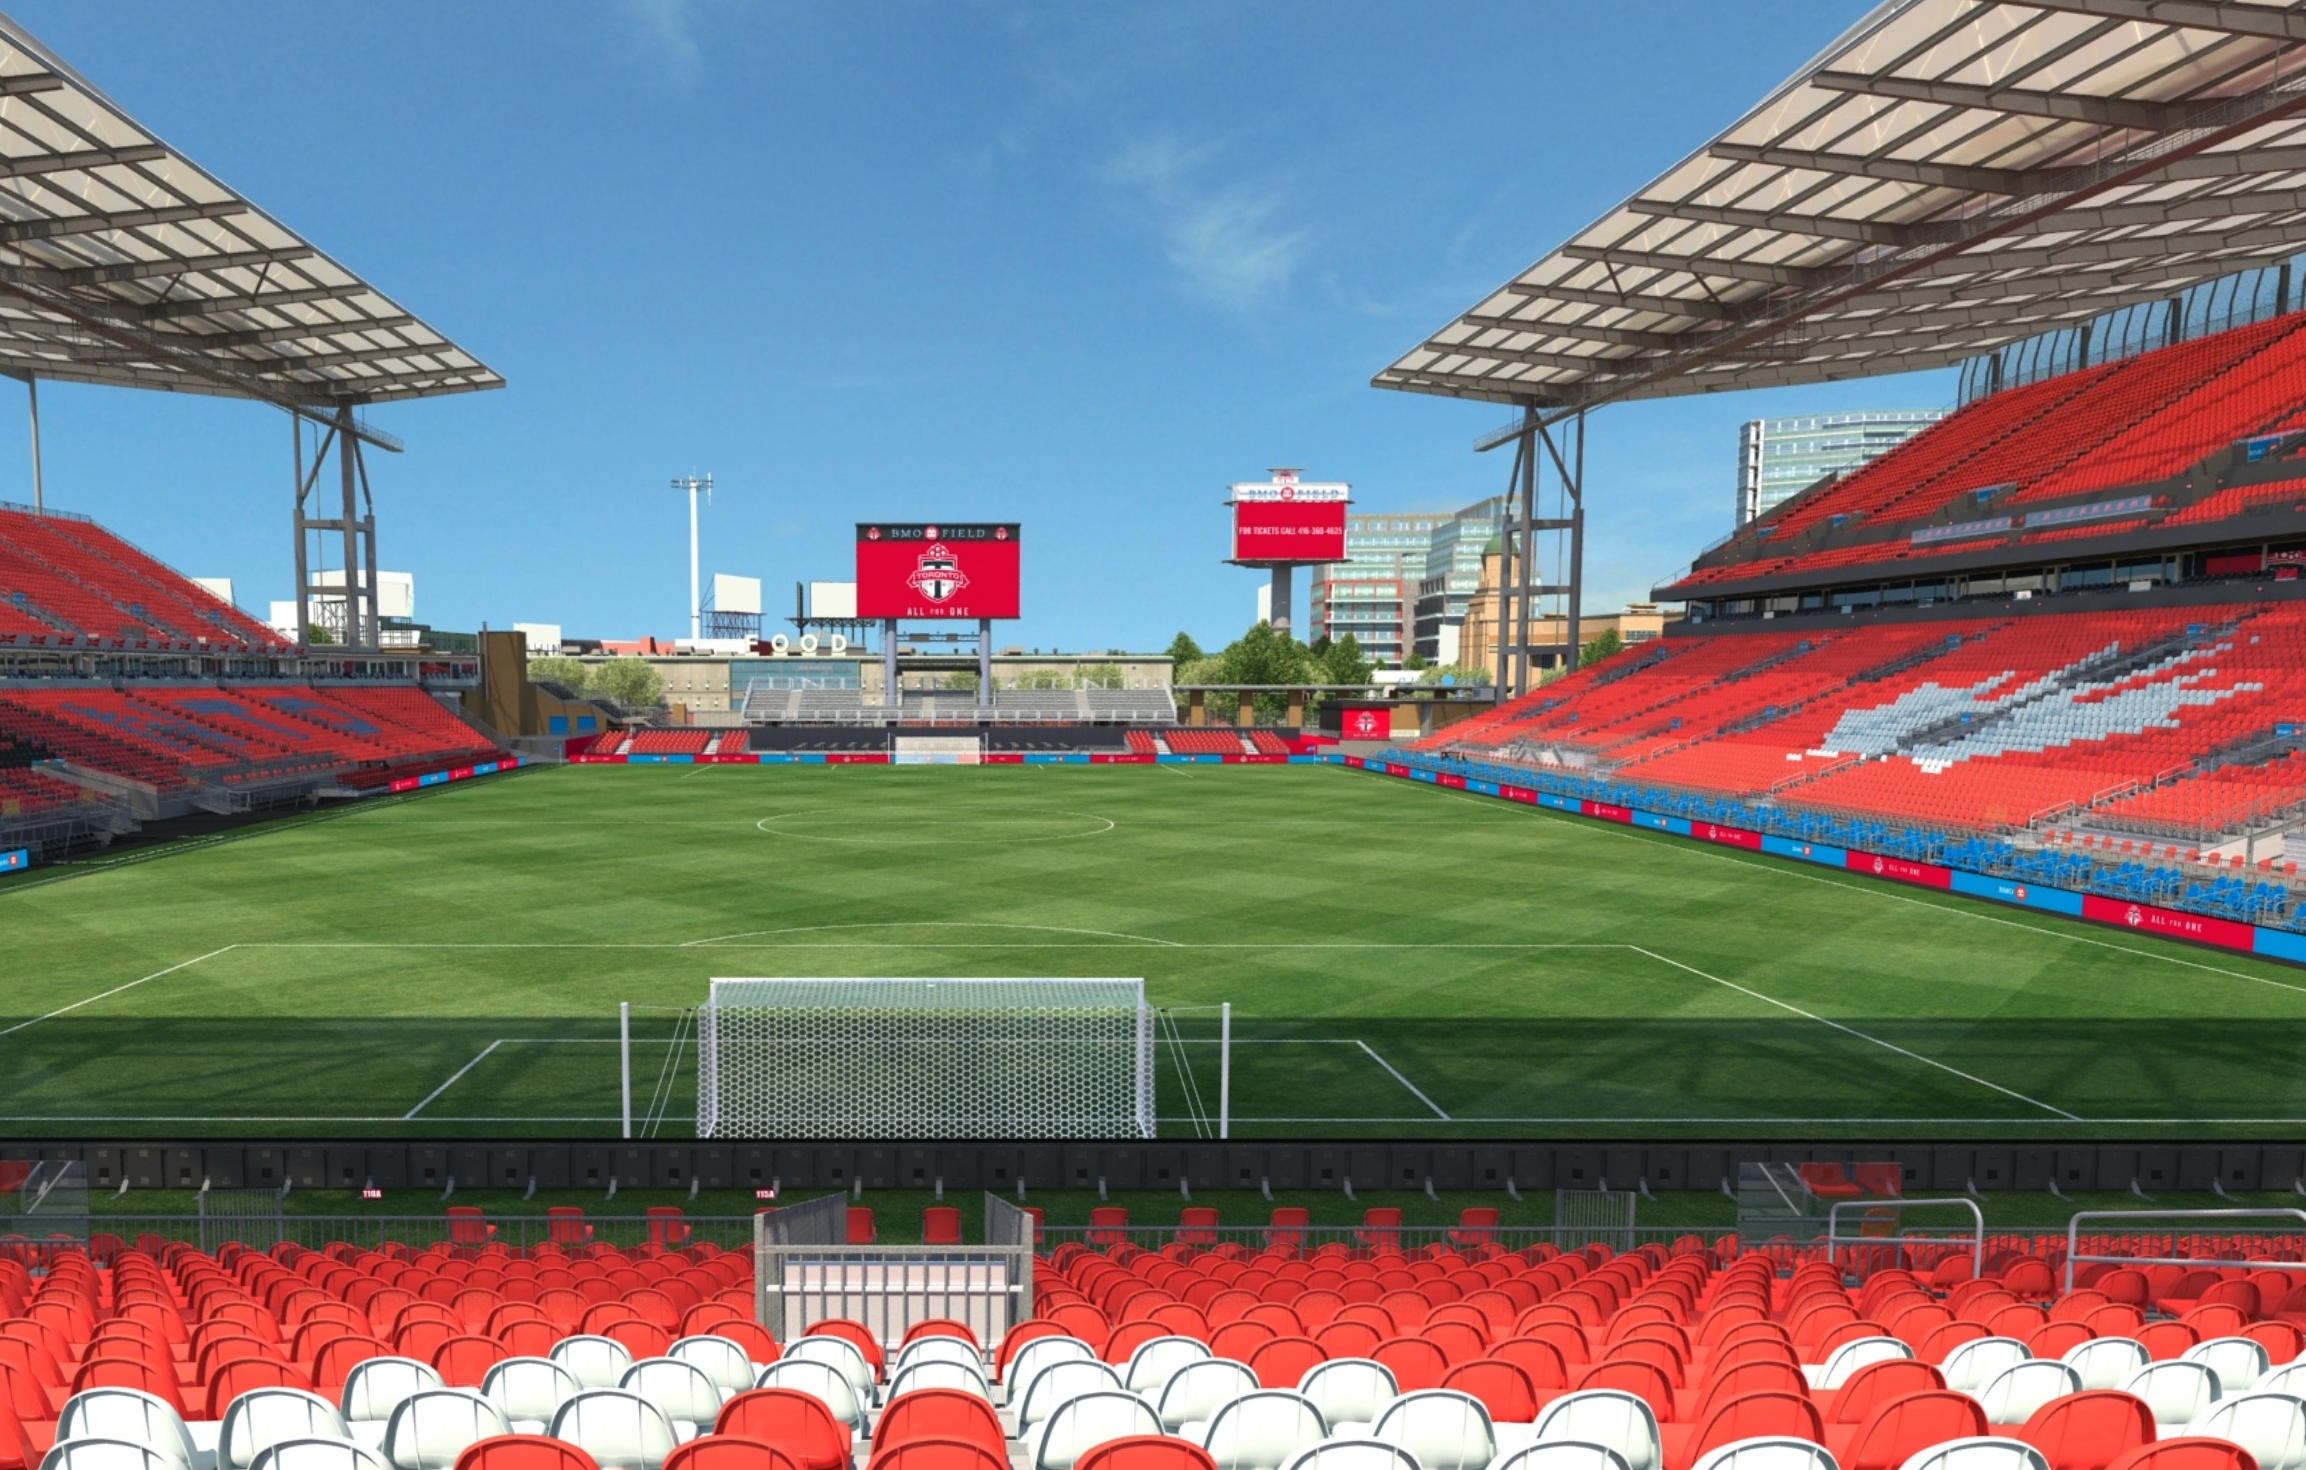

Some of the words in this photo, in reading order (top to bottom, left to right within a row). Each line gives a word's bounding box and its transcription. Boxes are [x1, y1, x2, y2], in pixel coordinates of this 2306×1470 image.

[891, 528, 923, 538] BMO
[942, 528, 986, 538] FIELD
[1238, 526, 1252, 535] FOR
[1253, 526, 1279, 535] TICKETS
[1280, 526, 1296, 535] CALL
[915, 570, 960, 580] TORONTO
[906, 606, 925, 617] ALL
[949, 606, 970, 617] ONE
[745, 633, 848, 653] FOOD
[2151, 914, 2166, 926] ALL
[2169, 919, 2182, 928] FOR
[2185, 921, 2203, 933] ONE
